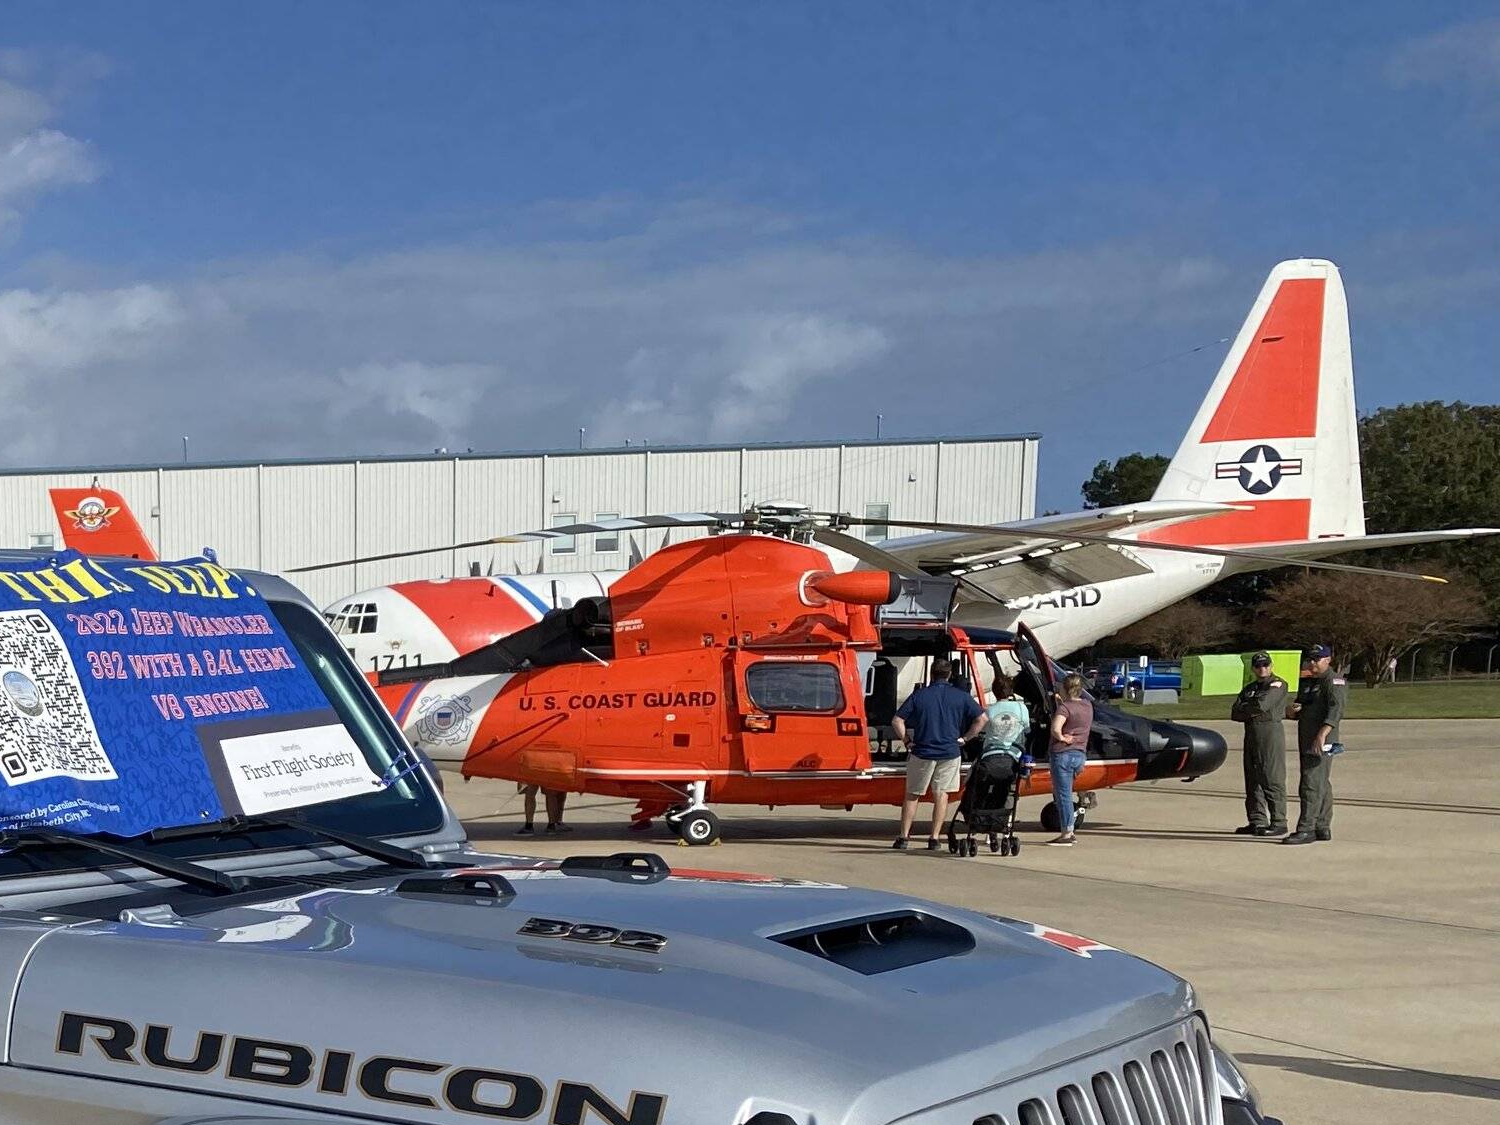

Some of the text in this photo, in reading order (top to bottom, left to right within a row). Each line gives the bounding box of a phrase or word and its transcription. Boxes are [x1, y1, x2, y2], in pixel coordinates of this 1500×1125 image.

[86, 651, 128, 680] 392
[128, 653, 187, 680] WITH
[186, 653, 203, 677] A
[239, 646, 296, 673] HEMI
[370, 653, 423, 671] 1711
[151, 686, 270, 721] V8 ENGINE!
[519, 691, 717, 712] U. S. COAST GUARD
[240, 751, 355, 781] First Flight Society
[37, 807, 48, 818] by
[47, 800, 78, 813] Carolina
[516, 916, 668, 955] 392
